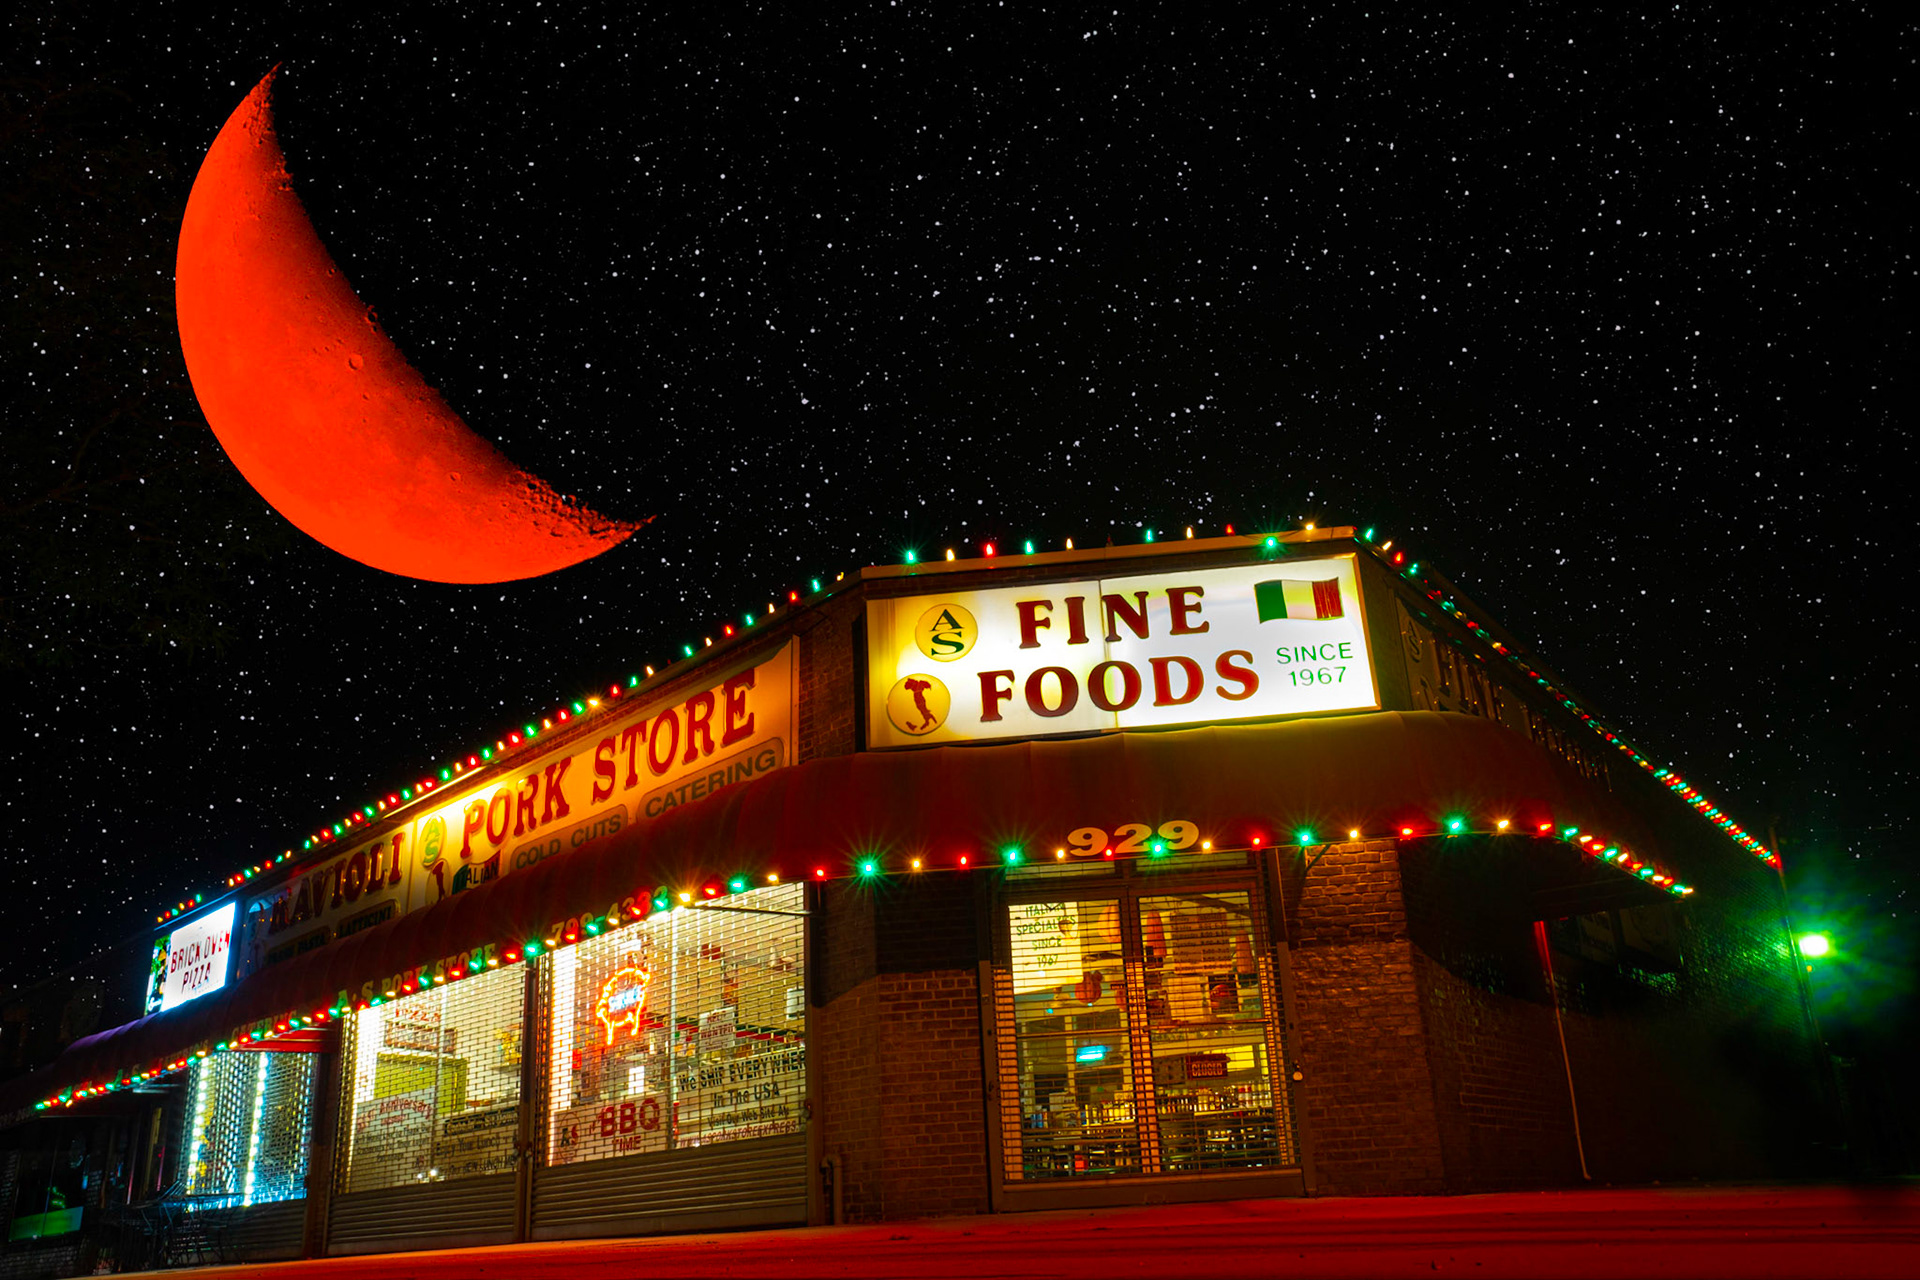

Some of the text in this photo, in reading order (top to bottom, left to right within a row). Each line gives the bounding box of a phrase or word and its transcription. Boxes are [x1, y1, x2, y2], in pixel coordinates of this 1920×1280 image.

[1015, 586, 1210, 650] FINE
[1276, 641, 1354, 665] SINCE
[977, 649, 1260, 722] FOODS
[1288, 665, 1348, 688] 1967
[460, 667, 756, 859] PORK STORE
[644, 748, 777, 819] CATERING
[515, 812, 622, 871] COLD CUTS
[1067, 820, 1199, 857] 929
[269, 832, 405, 936] RAVIOLI
[170, 940, 203, 974] BRICK
[203, 930, 231, 959] OVEN
[1031, 936, 1062, 951] SINCE
[1037, 953, 1059, 968] 1967
[181, 961, 211, 994] PIZZA
[678, 1074, 697, 1092] We
[700, 1066, 724, 1087] SHIP
[1191, 1062, 1224, 1078] CLOSED
[728, 1089, 750, 1105] The
[753, 1082, 780, 1101] USA
[600, 1097, 661, 1138] BBQ
[742, 1110, 758, 1122] Web
[611, 1135, 642, 1153] TIME
